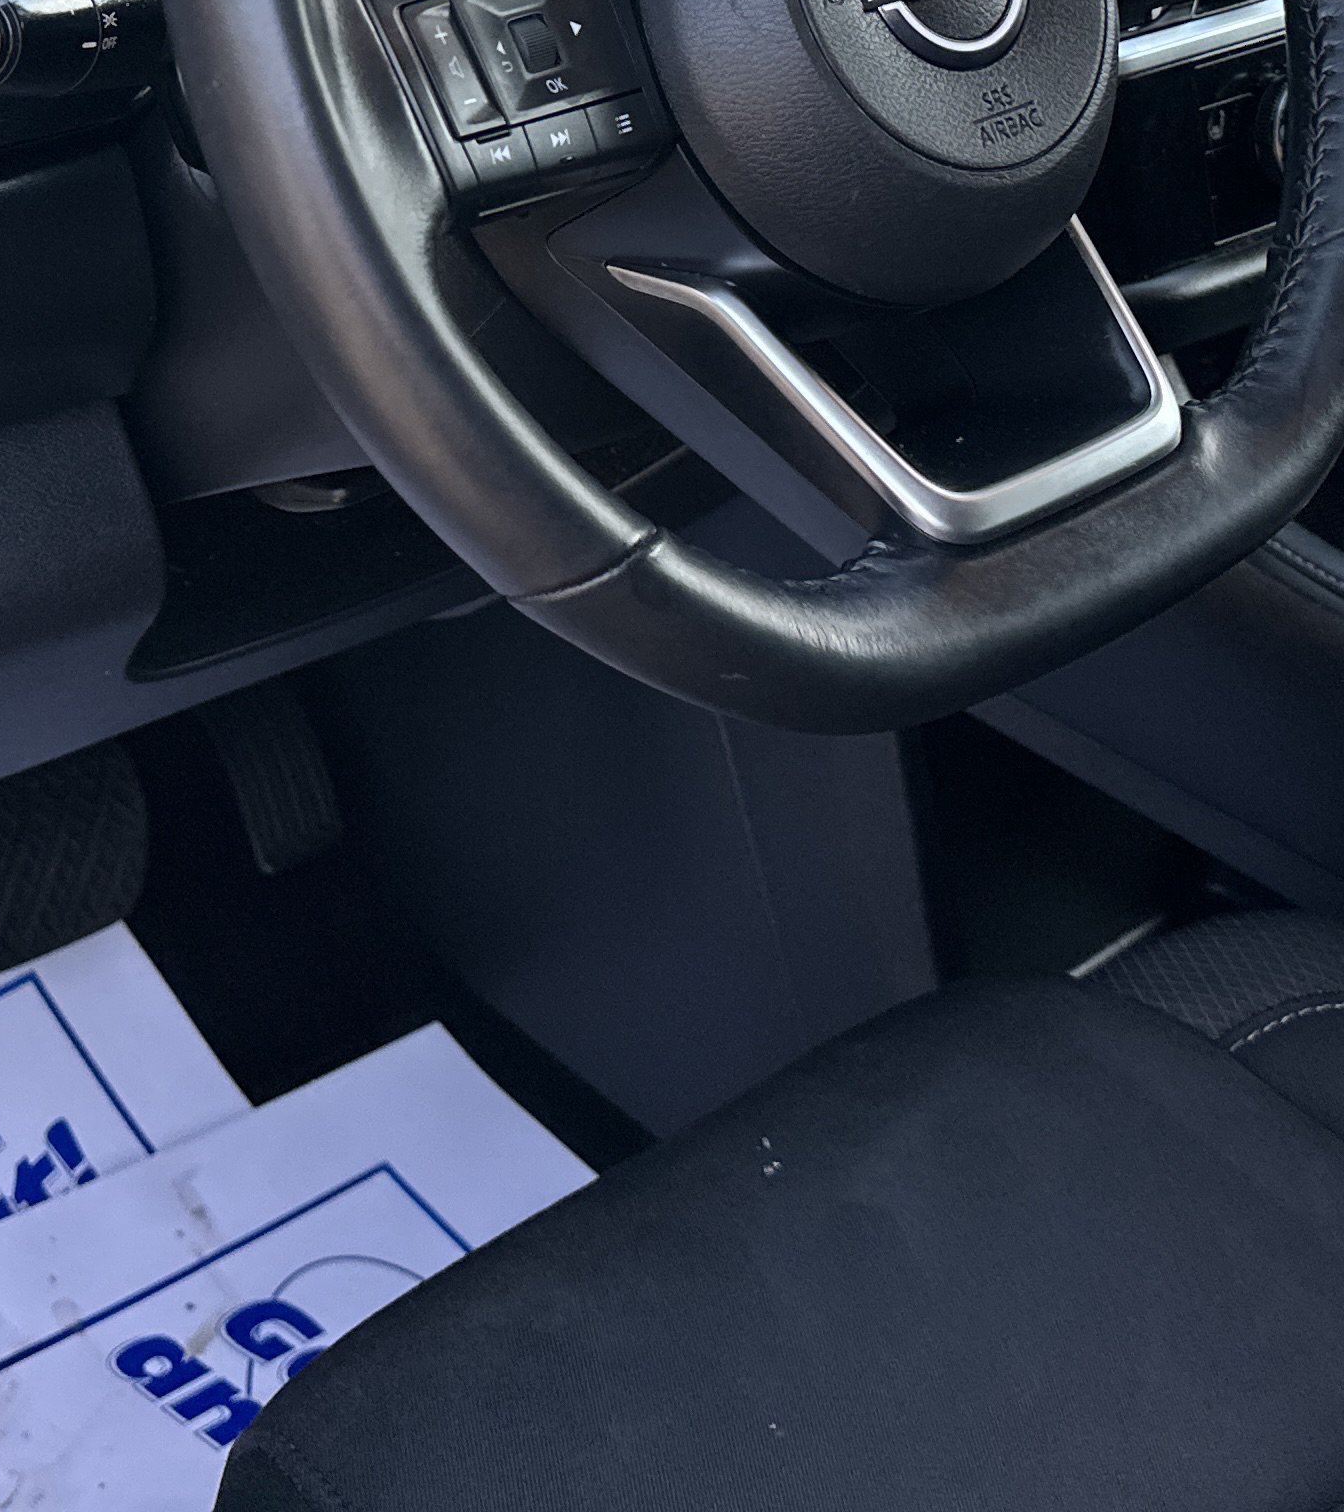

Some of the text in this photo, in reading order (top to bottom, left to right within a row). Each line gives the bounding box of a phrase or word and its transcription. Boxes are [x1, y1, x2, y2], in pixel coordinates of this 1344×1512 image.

[545, 76, 569, 94] OK
[978, 108, 1045, 147] AIRBAG
[111, 1335, 264, 1447] an
